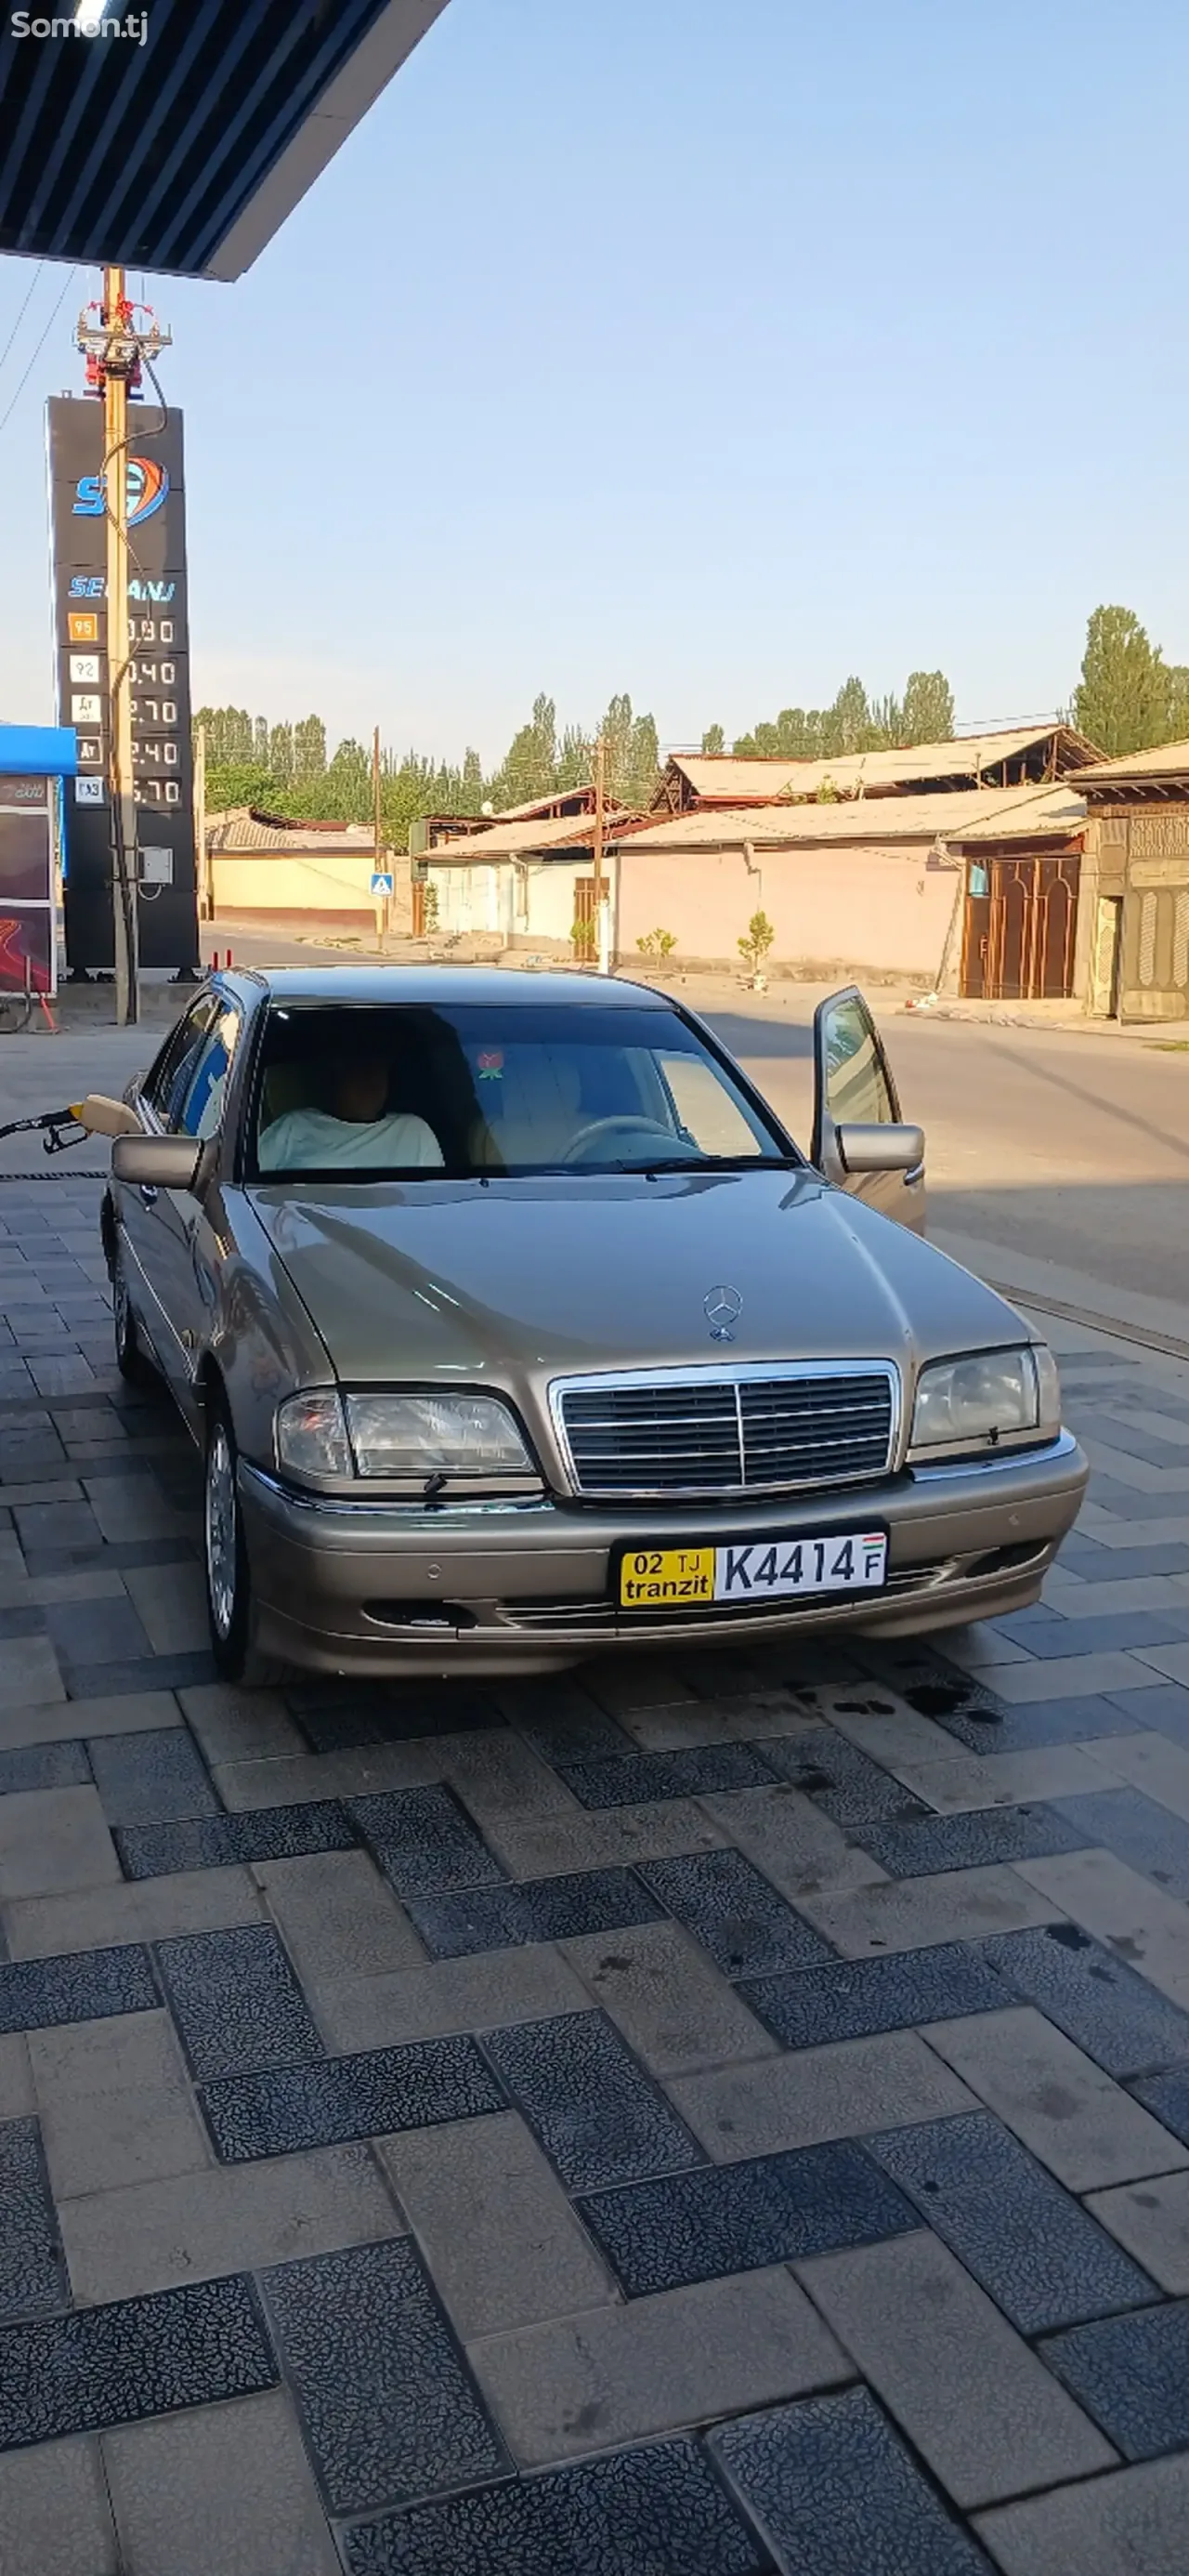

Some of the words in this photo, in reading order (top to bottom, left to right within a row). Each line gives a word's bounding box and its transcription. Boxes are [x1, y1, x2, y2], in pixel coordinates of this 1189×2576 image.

[68, 575, 176, 602] SEANJ
[75, 621, 92, 636] 95
[76, 663, 94, 677] 92
[634, 1553, 663, 1575] 02
[678, 1554, 700, 1572] TJ
[725, 1539, 856, 1592] K4414
[865, 1553, 882, 1579] F
[625, 1574, 709, 1599] tranzit
